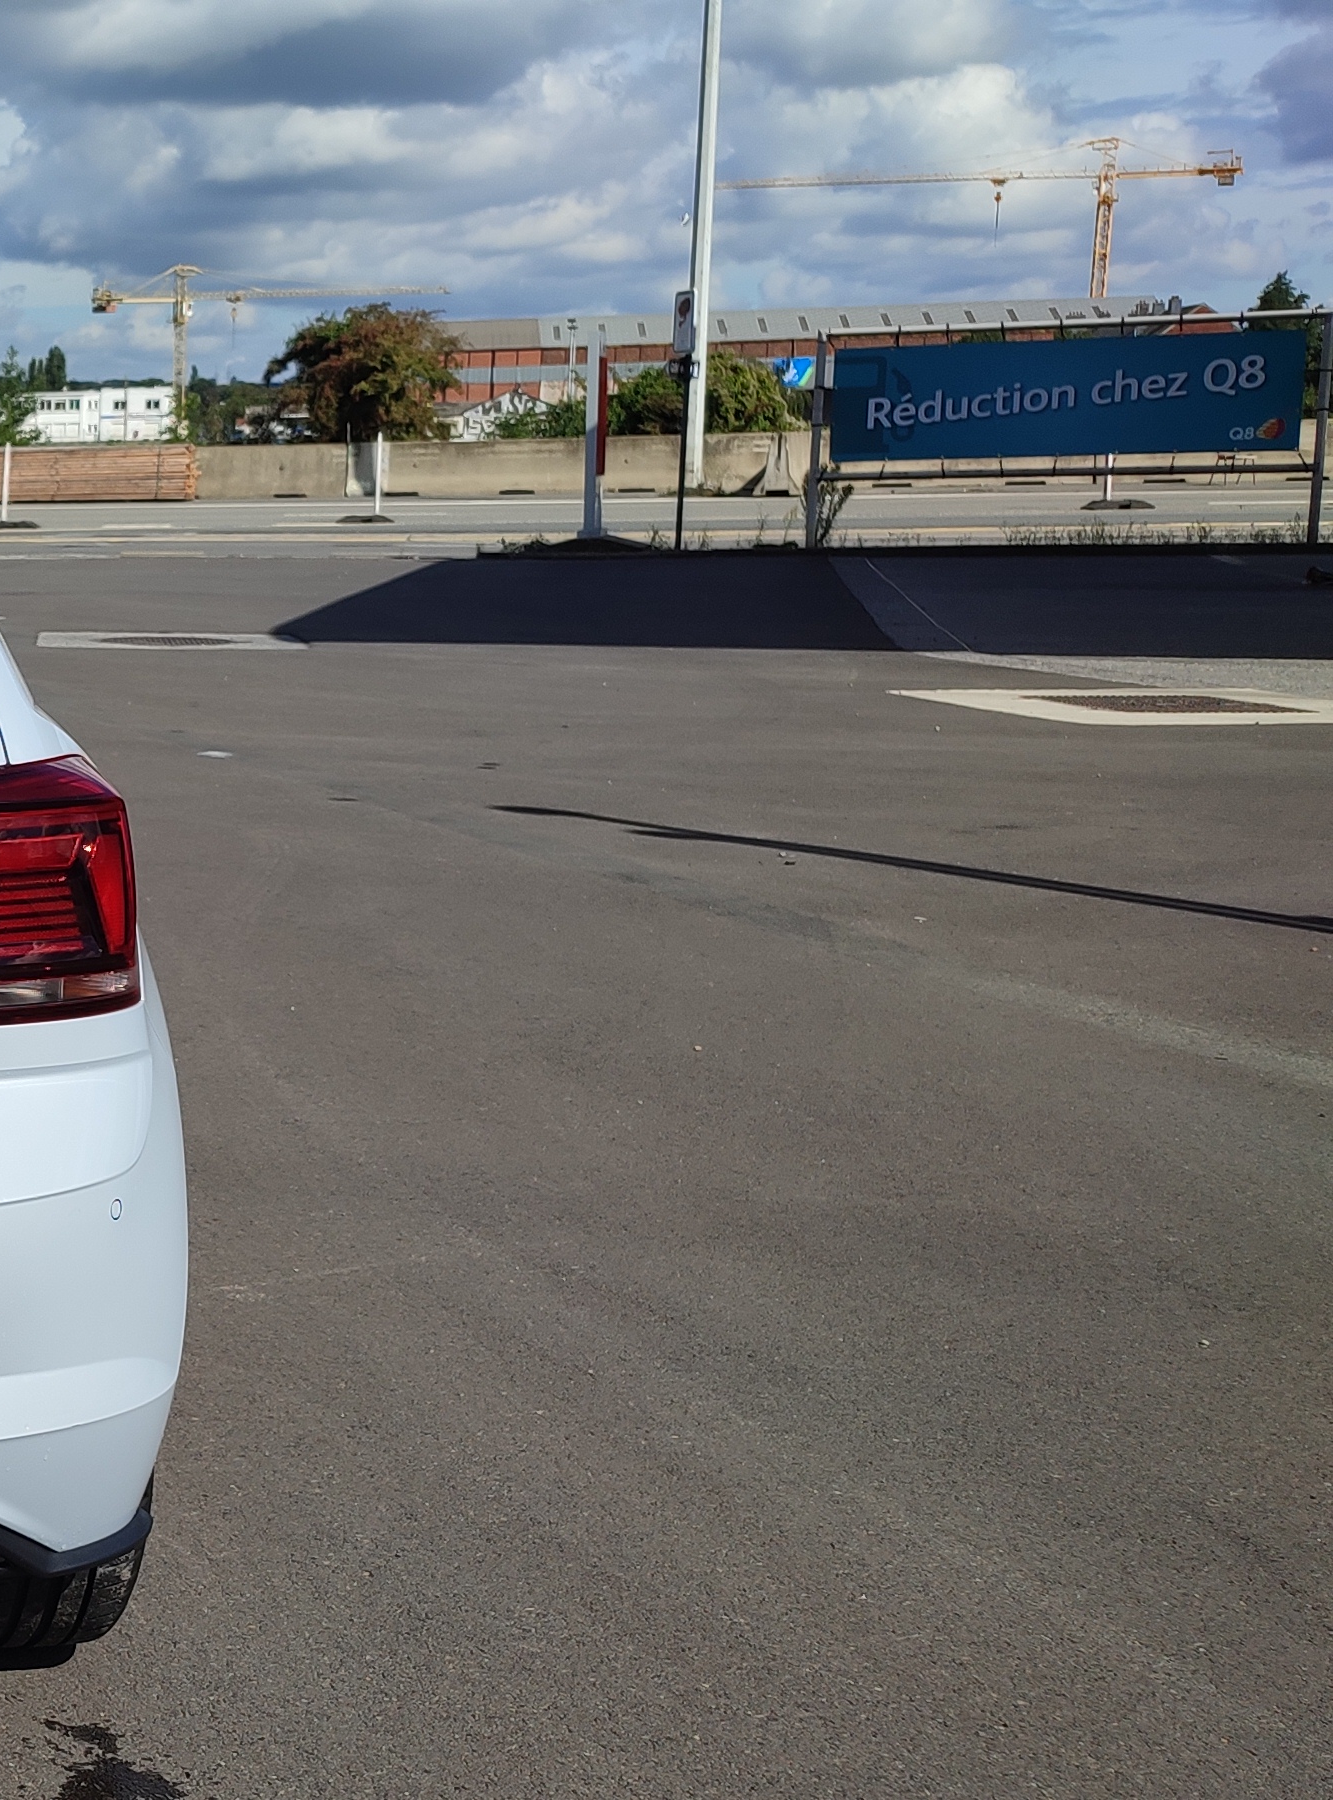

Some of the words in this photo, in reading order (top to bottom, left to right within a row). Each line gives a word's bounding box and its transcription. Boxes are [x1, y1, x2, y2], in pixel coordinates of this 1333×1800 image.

[866, 381, 1076, 431] Réduction
[1090, 368, 1189, 407] chez
[1202, 354, 1267, 397] Q8
[1229, 426, 1255, 440] Q8
